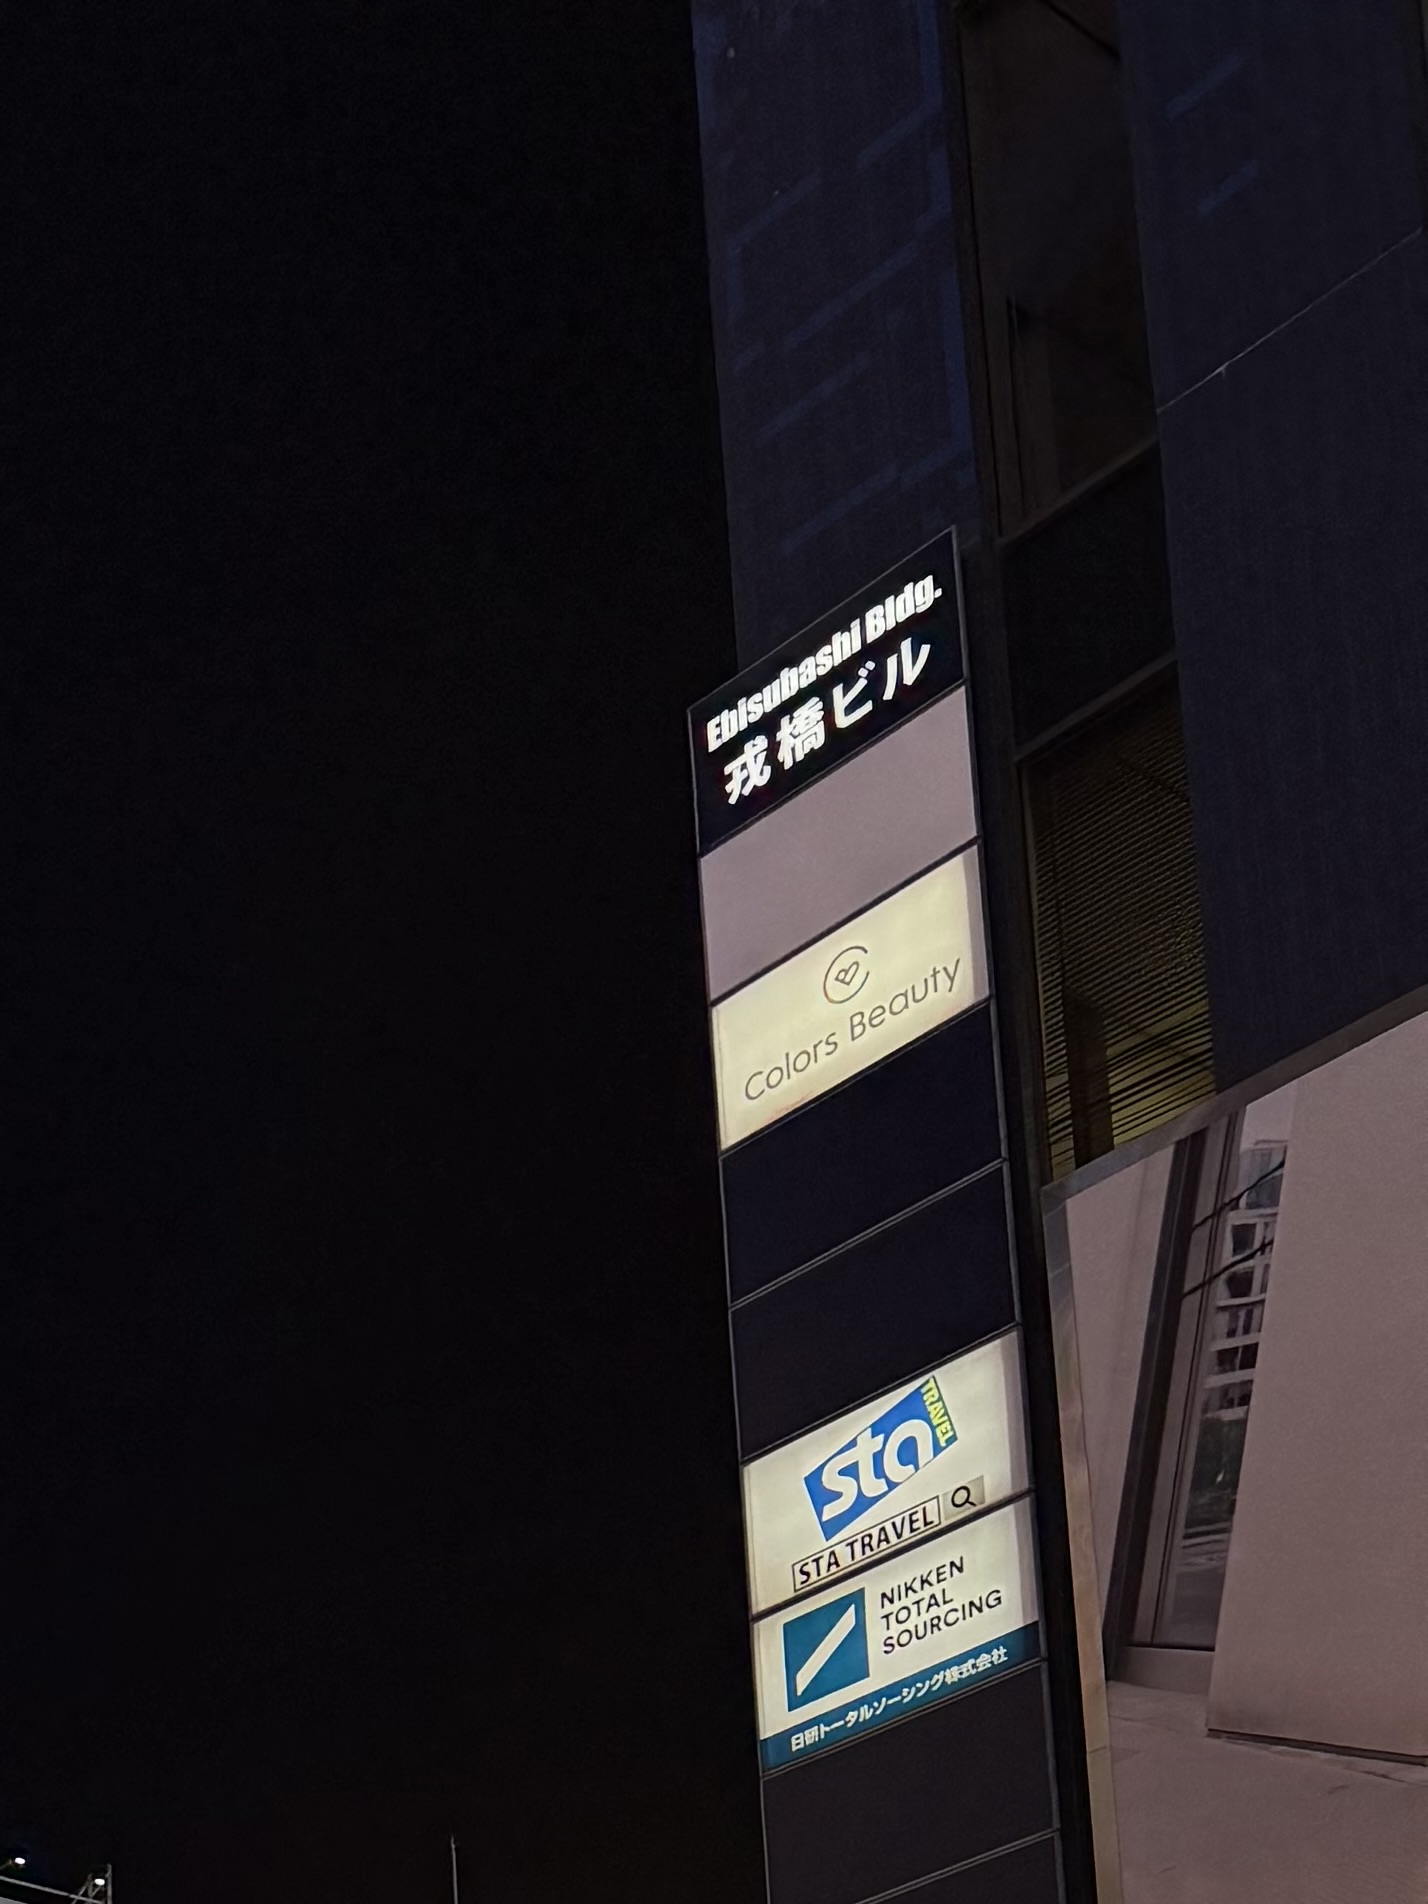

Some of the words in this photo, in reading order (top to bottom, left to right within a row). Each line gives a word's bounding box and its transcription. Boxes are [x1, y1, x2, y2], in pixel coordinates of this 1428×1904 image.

[706, 618, 863, 753] Ebisubashi
[864, 573, 943, 643] Bldg.
[723, 636, 931, 805] 戎橋ビル
[743, 1030, 839, 1104] Colors
[849, 956, 963, 1045] Beauty
[920, 1377, 957, 1448] TRAVEL
[821, 1418, 937, 1522] sta
[797, 1550, 841, 1587] STA
[845, 1507, 937, 1562] TRAVEL
[879, 1556, 965, 1610] NIKKEN
[880, 1589, 954, 1633] TOTAL
[881, 1589, 1003, 1656] SOURCING
